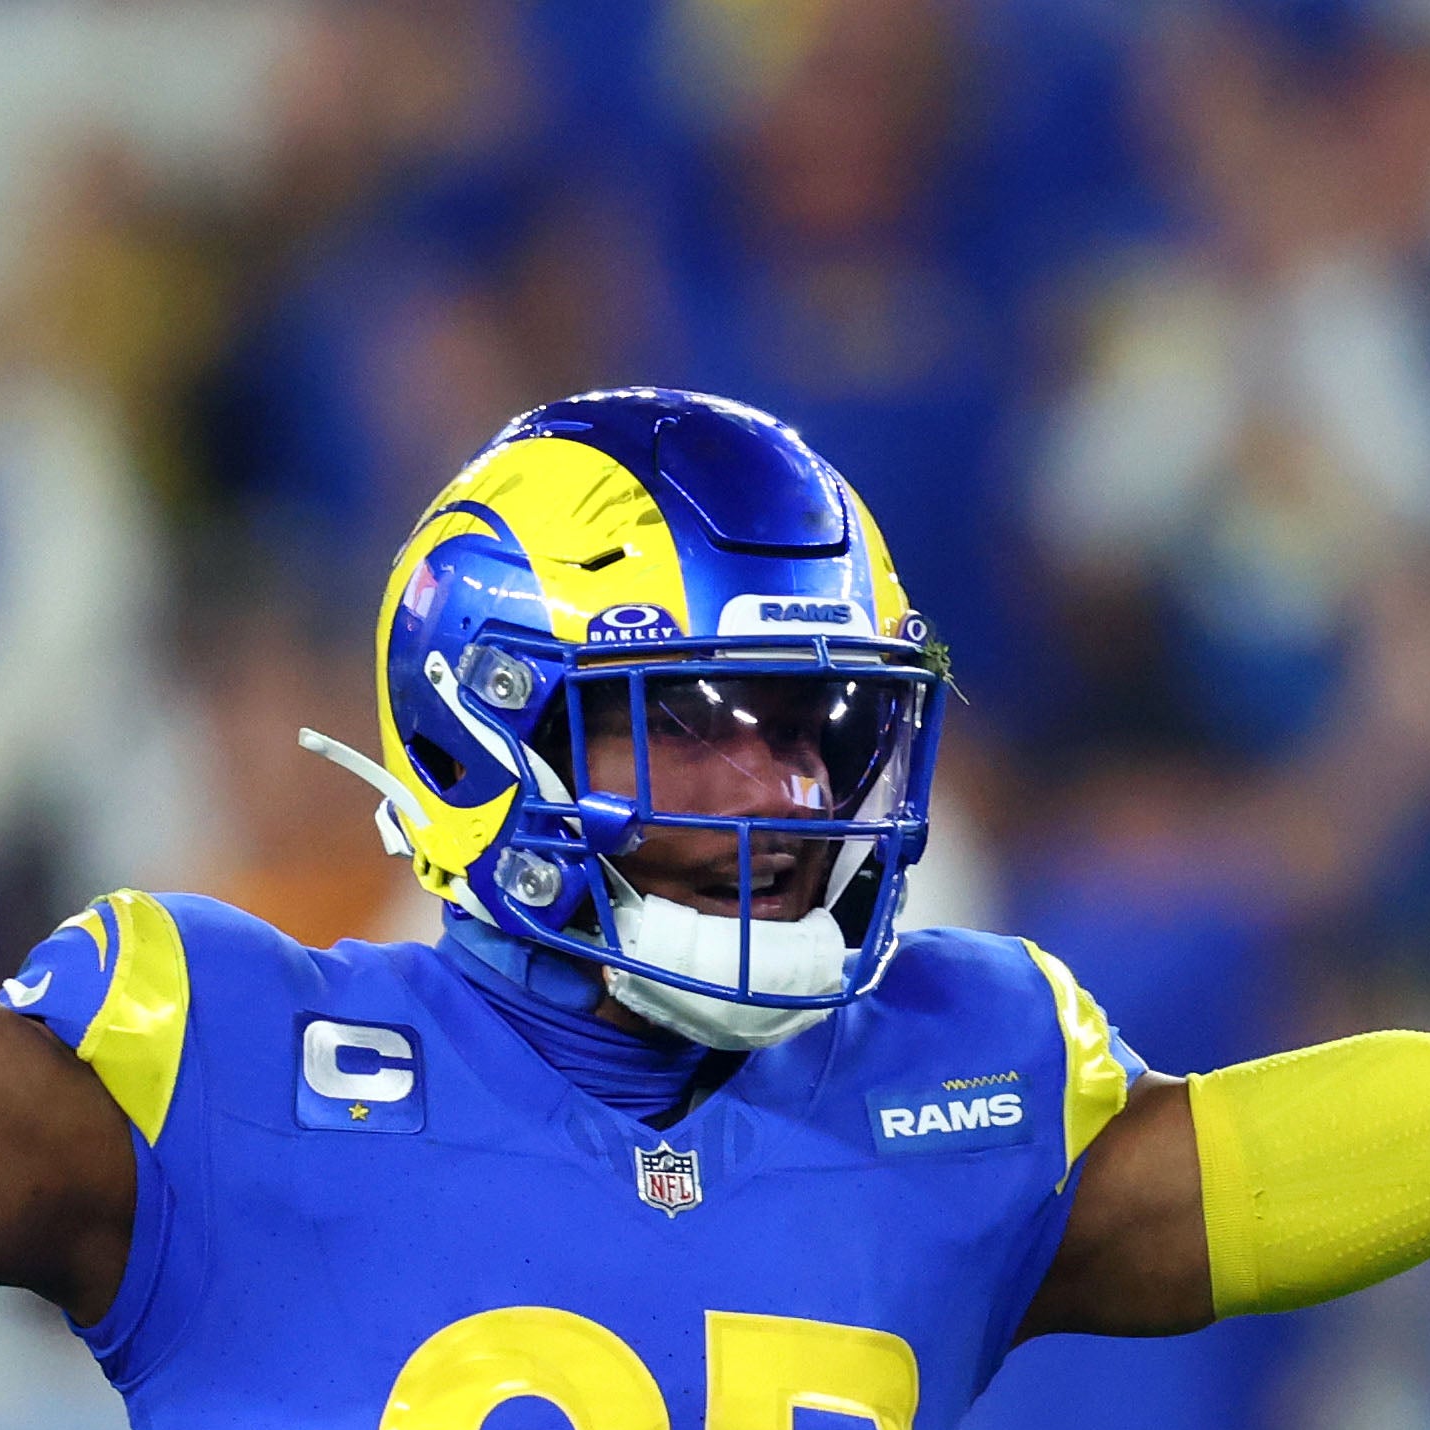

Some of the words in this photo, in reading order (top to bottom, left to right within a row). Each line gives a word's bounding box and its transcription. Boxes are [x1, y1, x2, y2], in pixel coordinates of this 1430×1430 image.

[760, 603, 851, 624] RAMS
[590, 627, 673, 642] OAKLEY
[303, 1020, 414, 1103] C
[879, 1093, 1023, 1138] RAMS
[649, 1174, 691, 1204] NFL
